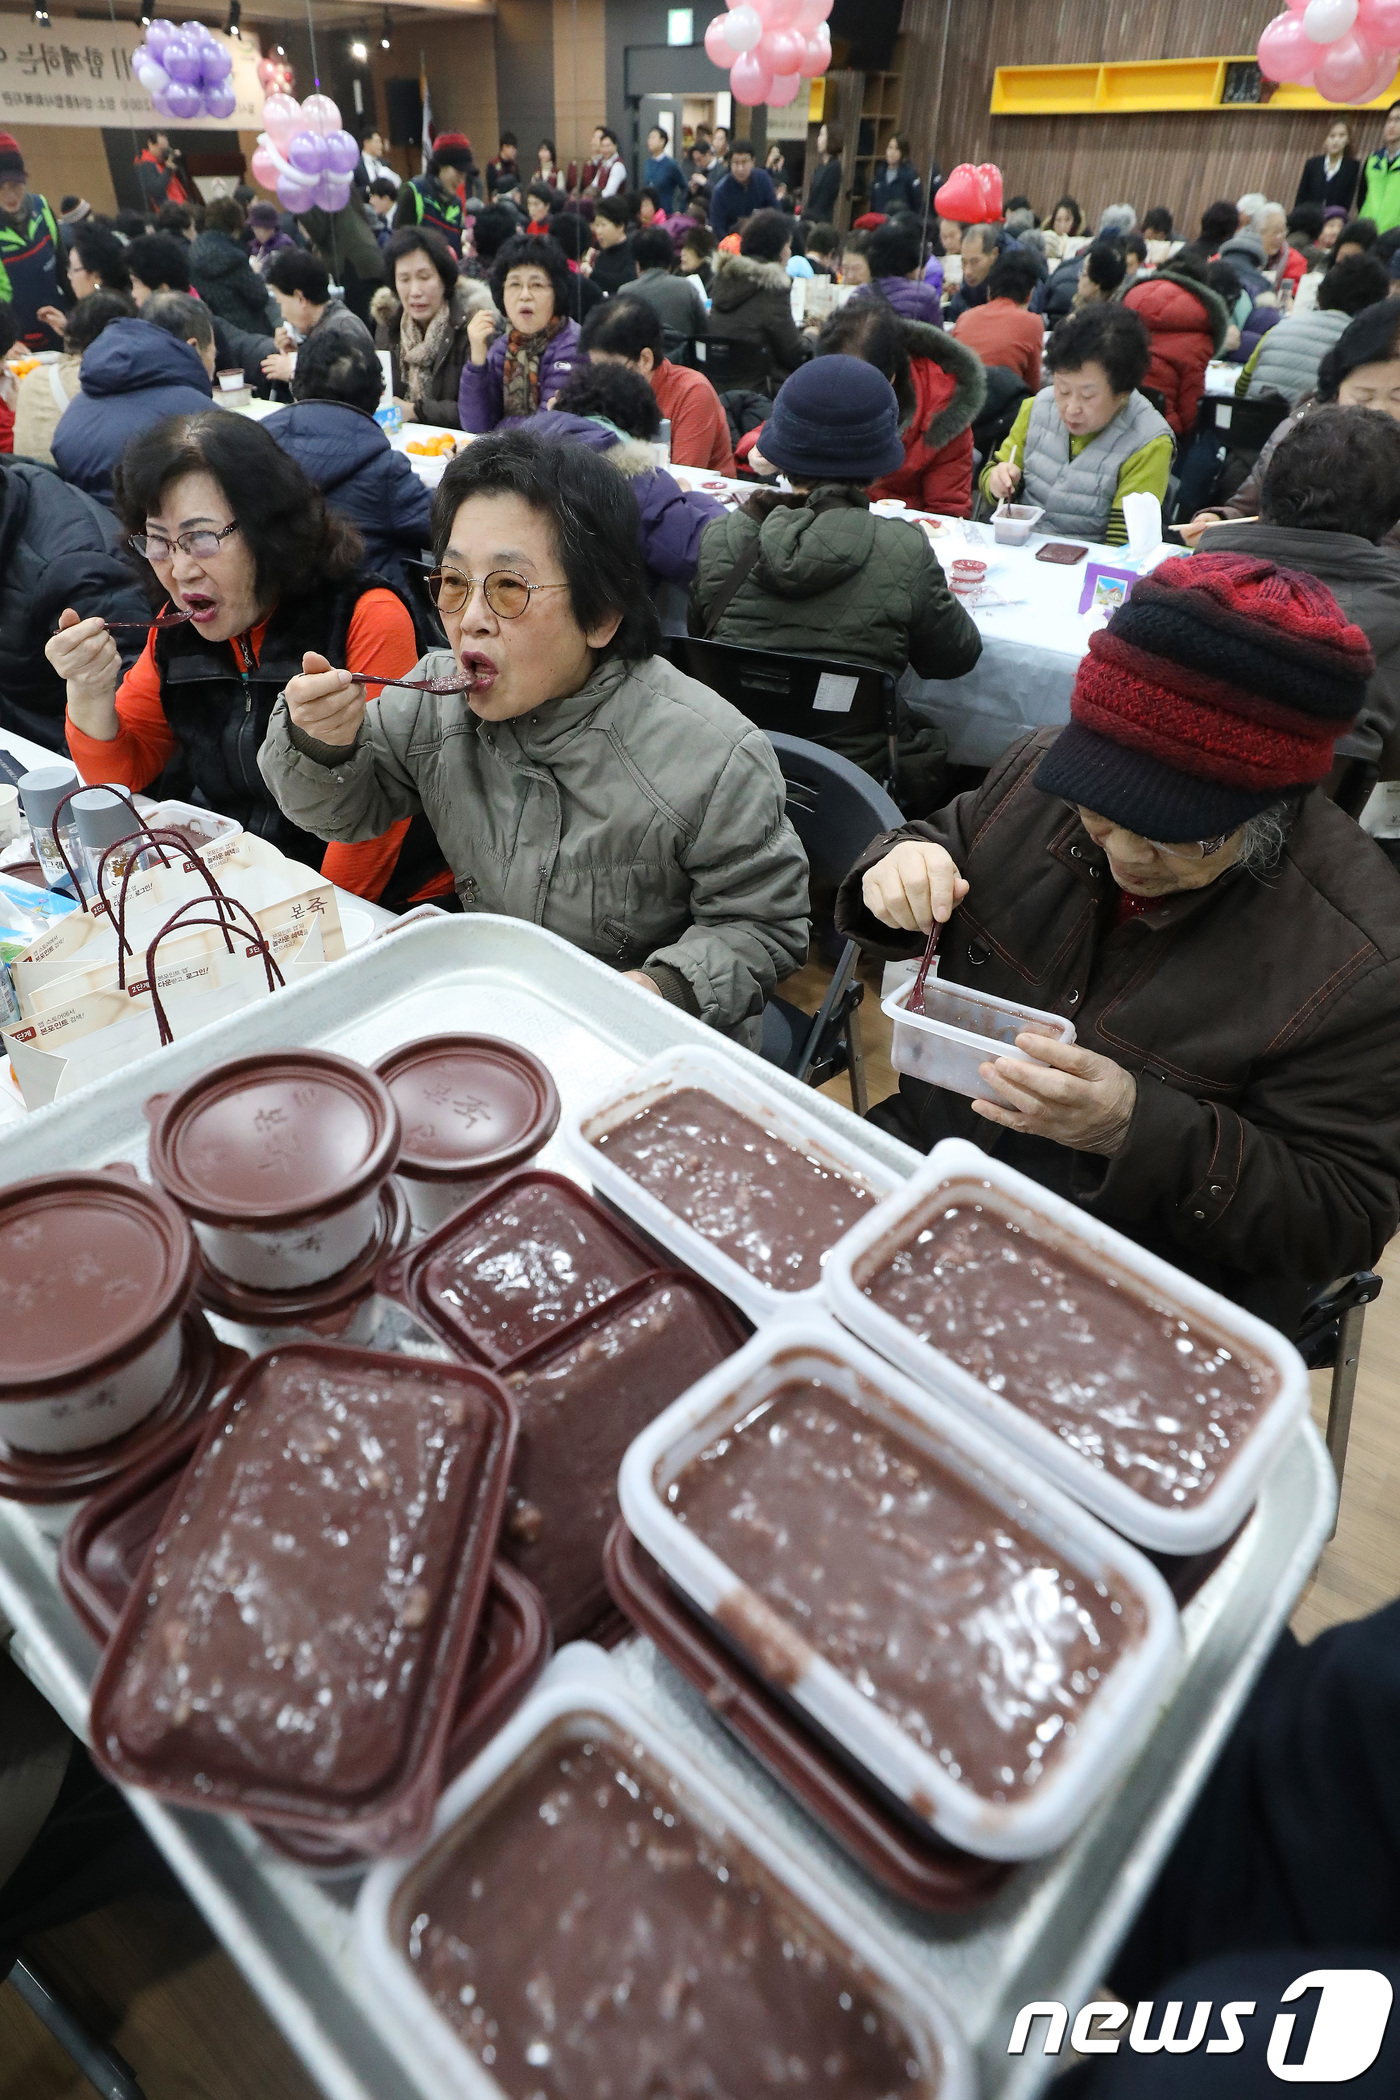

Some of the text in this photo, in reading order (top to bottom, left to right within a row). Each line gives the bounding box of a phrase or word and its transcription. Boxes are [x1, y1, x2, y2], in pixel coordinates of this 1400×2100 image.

[135, 883, 153, 896] 로그인!
[291, 896, 328, 919] 본죽
[35, 945, 54, 962] 본포인트
[186, 967, 209, 980] 로그인!
[131, 982, 150, 993] 2단계
[46, 1009, 75, 1024] 스토어에서
[40, 1019, 69, 1035] 본포인트
[11, 1030, 32, 1041] 단계
